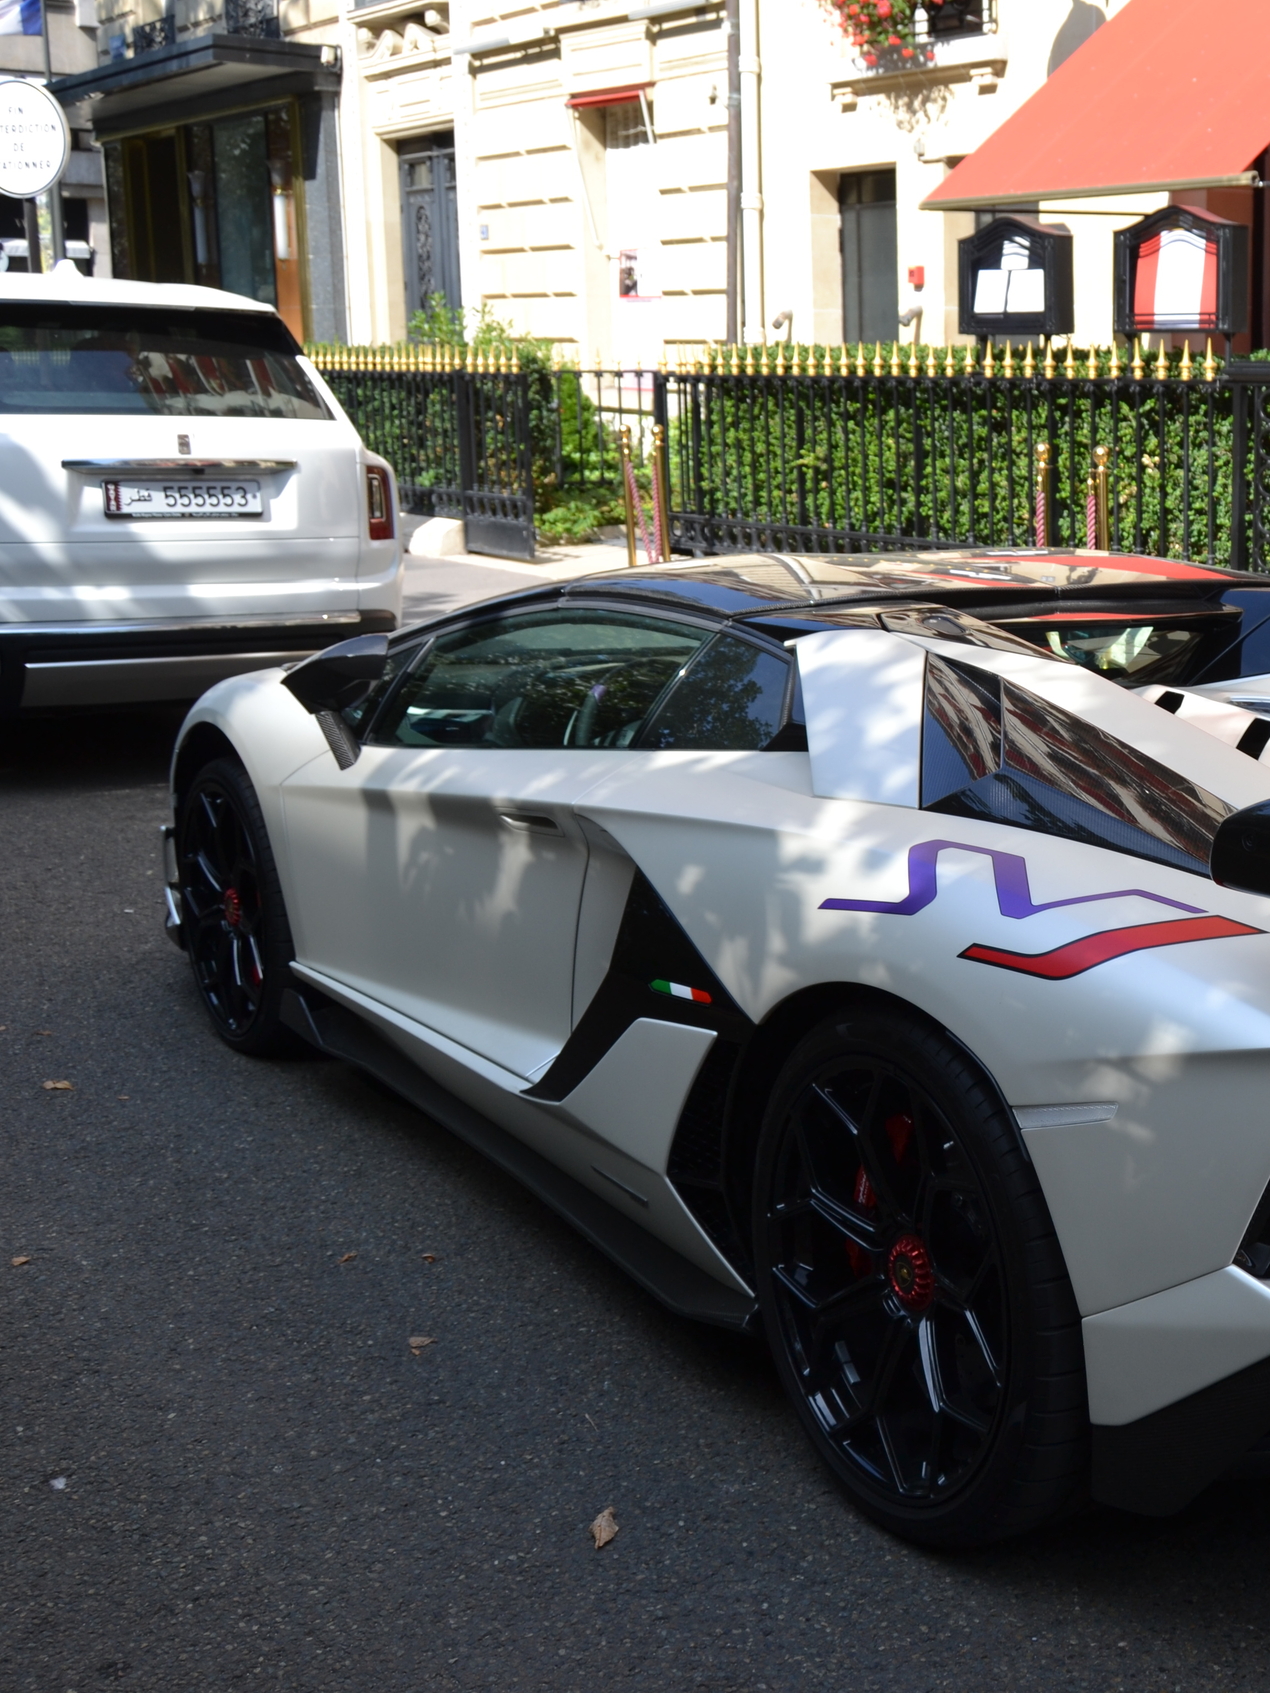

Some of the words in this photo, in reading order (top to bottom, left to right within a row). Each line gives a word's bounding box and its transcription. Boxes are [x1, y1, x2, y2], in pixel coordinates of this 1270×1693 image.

[8, 106, 24, 115] FIN
[13, 142, 24, 152] DE
[0, 160, 51, 170] ATIONNER
[162, 485, 249, 508] 555553
